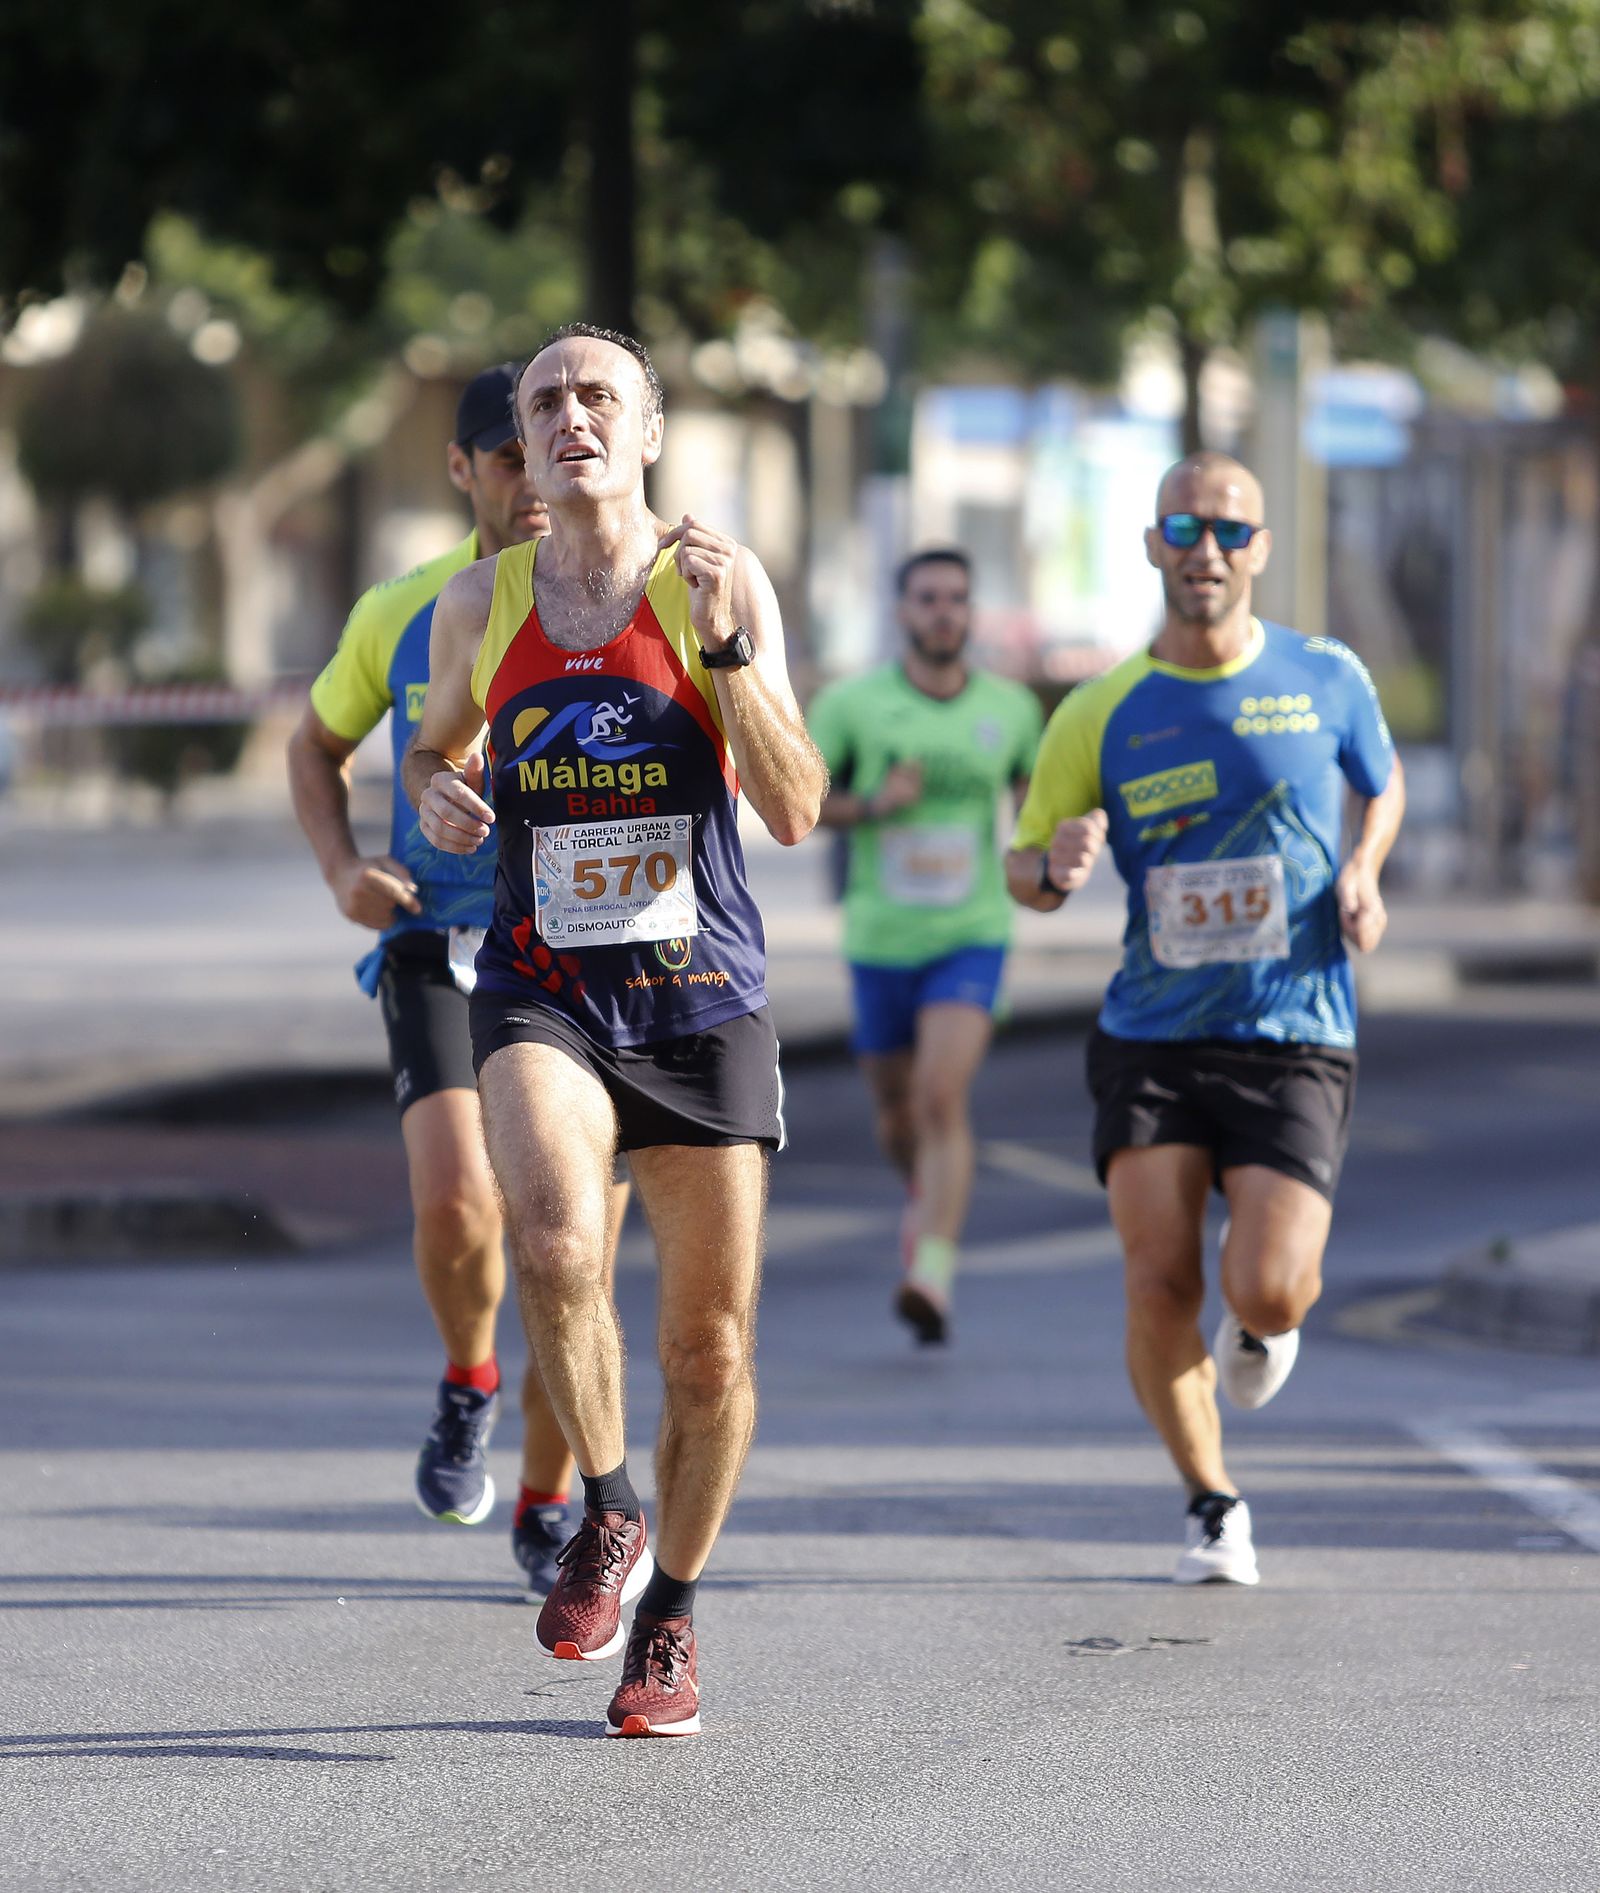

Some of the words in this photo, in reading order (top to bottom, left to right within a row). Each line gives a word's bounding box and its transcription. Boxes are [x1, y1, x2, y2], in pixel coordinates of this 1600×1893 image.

[517, 757, 668, 795] Málaga
[573, 828, 625, 839] CARRERA
[627, 822, 671, 834] URBANA
[553, 840, 568, 851] EL
[570, 837, 622, 850] TORCAL
[627, 833, 643, 844] LA
[646, 831, 671, 842] PAZ
[573, 851, 677, 900] 570
[1181, 885, 1271, 926] 315
[567, 918, 636, 933] DISMOAUTO
[625, 969, 666, 989] sabor
[672, 974, 682, 988] a
[687, 971, 730, 988] mango
